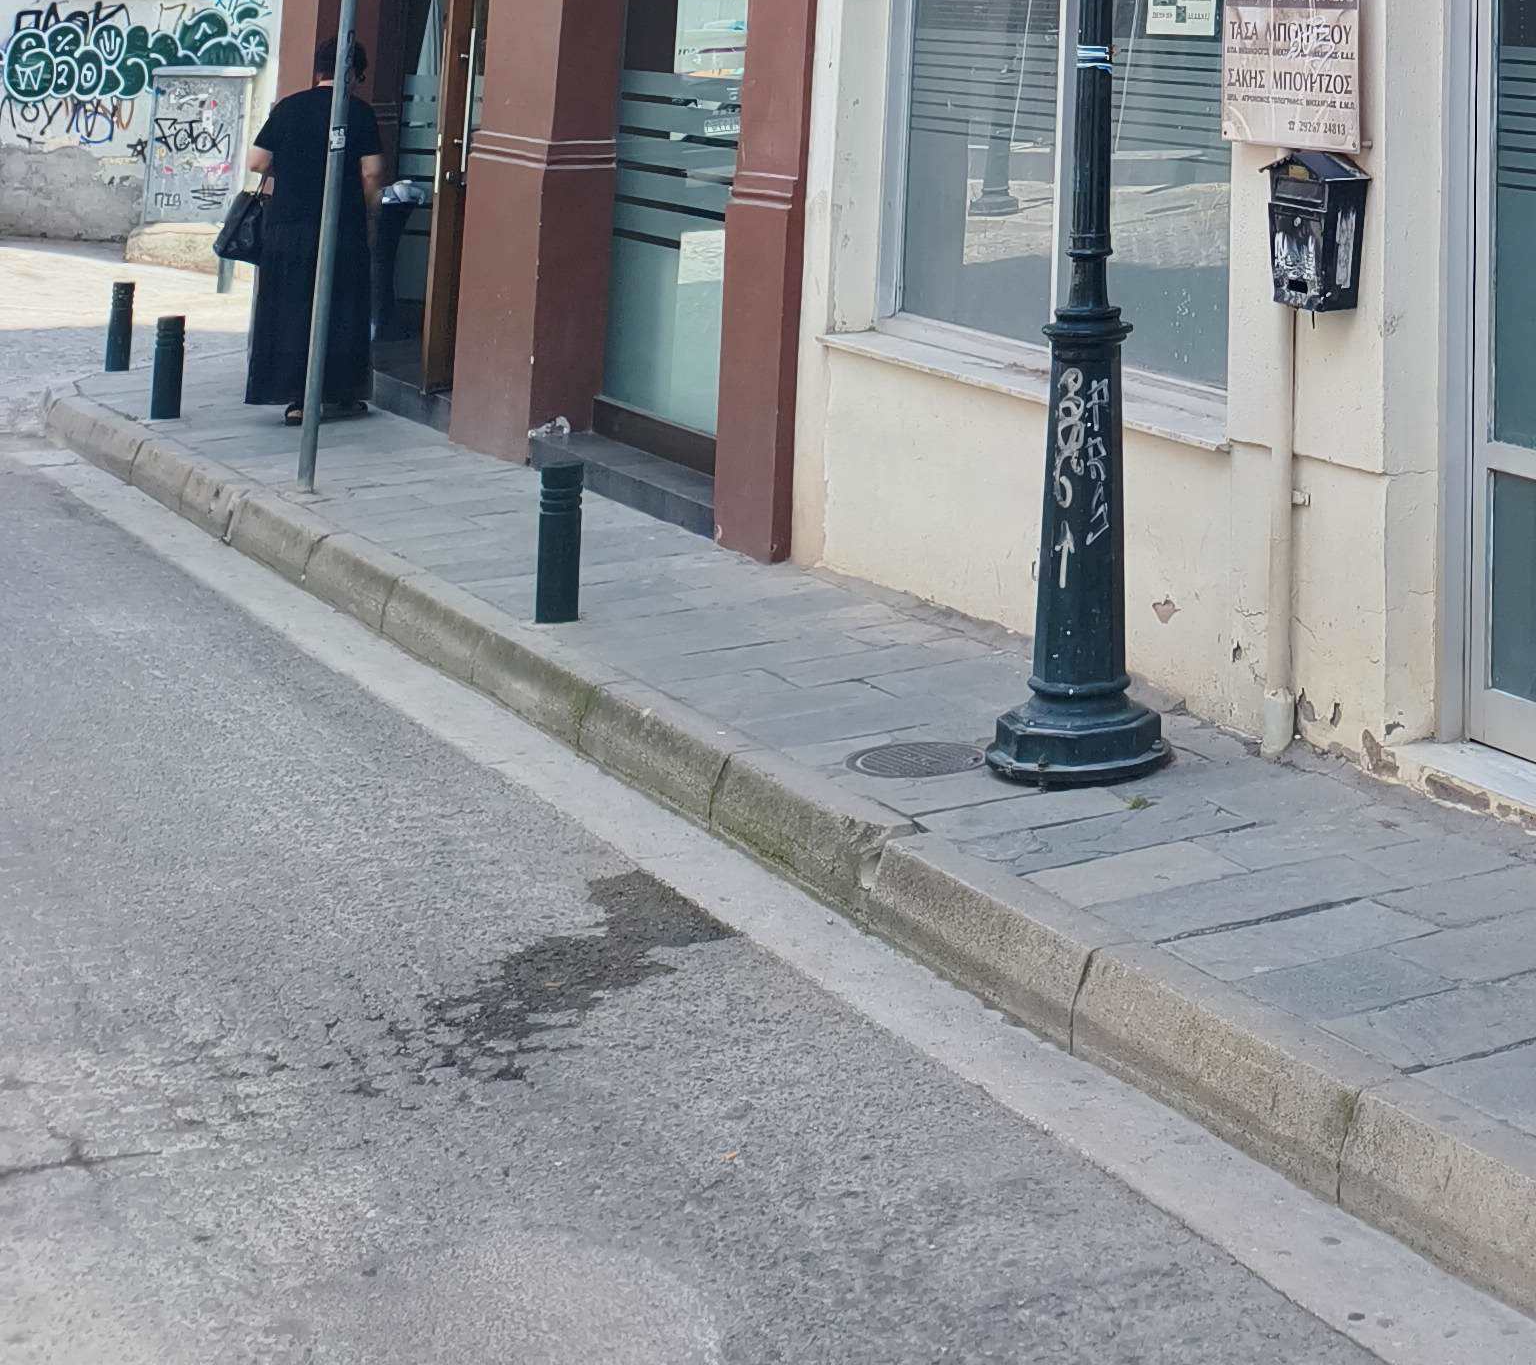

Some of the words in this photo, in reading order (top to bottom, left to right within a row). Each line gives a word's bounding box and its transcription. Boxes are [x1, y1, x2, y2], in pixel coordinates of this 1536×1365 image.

[1229, 20, 1259, 41] ΤΑΣΑ
[1227, 68, 1266, 89] ΣΑΚΗΣ
[1272, 70, 1353, 95] ΜΠΟΥΡΤΖΟΣ
